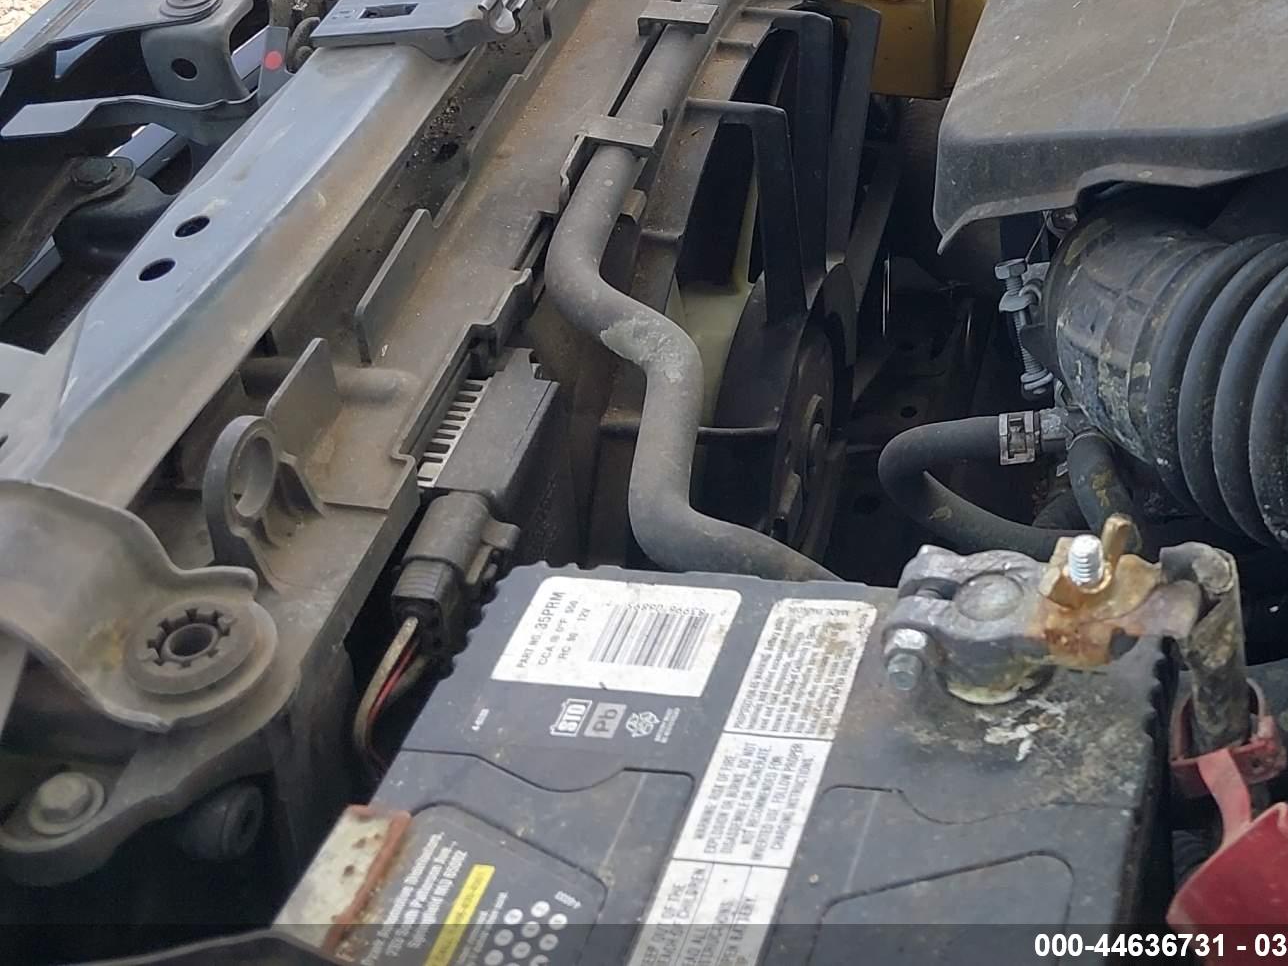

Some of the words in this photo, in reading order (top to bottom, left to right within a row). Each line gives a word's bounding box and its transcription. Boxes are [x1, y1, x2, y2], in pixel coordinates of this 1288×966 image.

[516, 647, 535, 668] PART
[534, 591, 566, 630] 35PRM
[537, 645, 556, 666] CCA
[557, 645, 572, 660] RC
[592, 708, 619, 733] Pb
[746, 771, 778, 828] RECOMMENDED
[750, 824, 774, 860] INVERTED
[771, 773, 793, 803] FOLLOW
[782, 743, 805, 772] PROPER
[703, 812, 730, 853] EXPLOSION
[770, 811, 796, 850] CHARGING
[666, 883, 686, 902] THE
